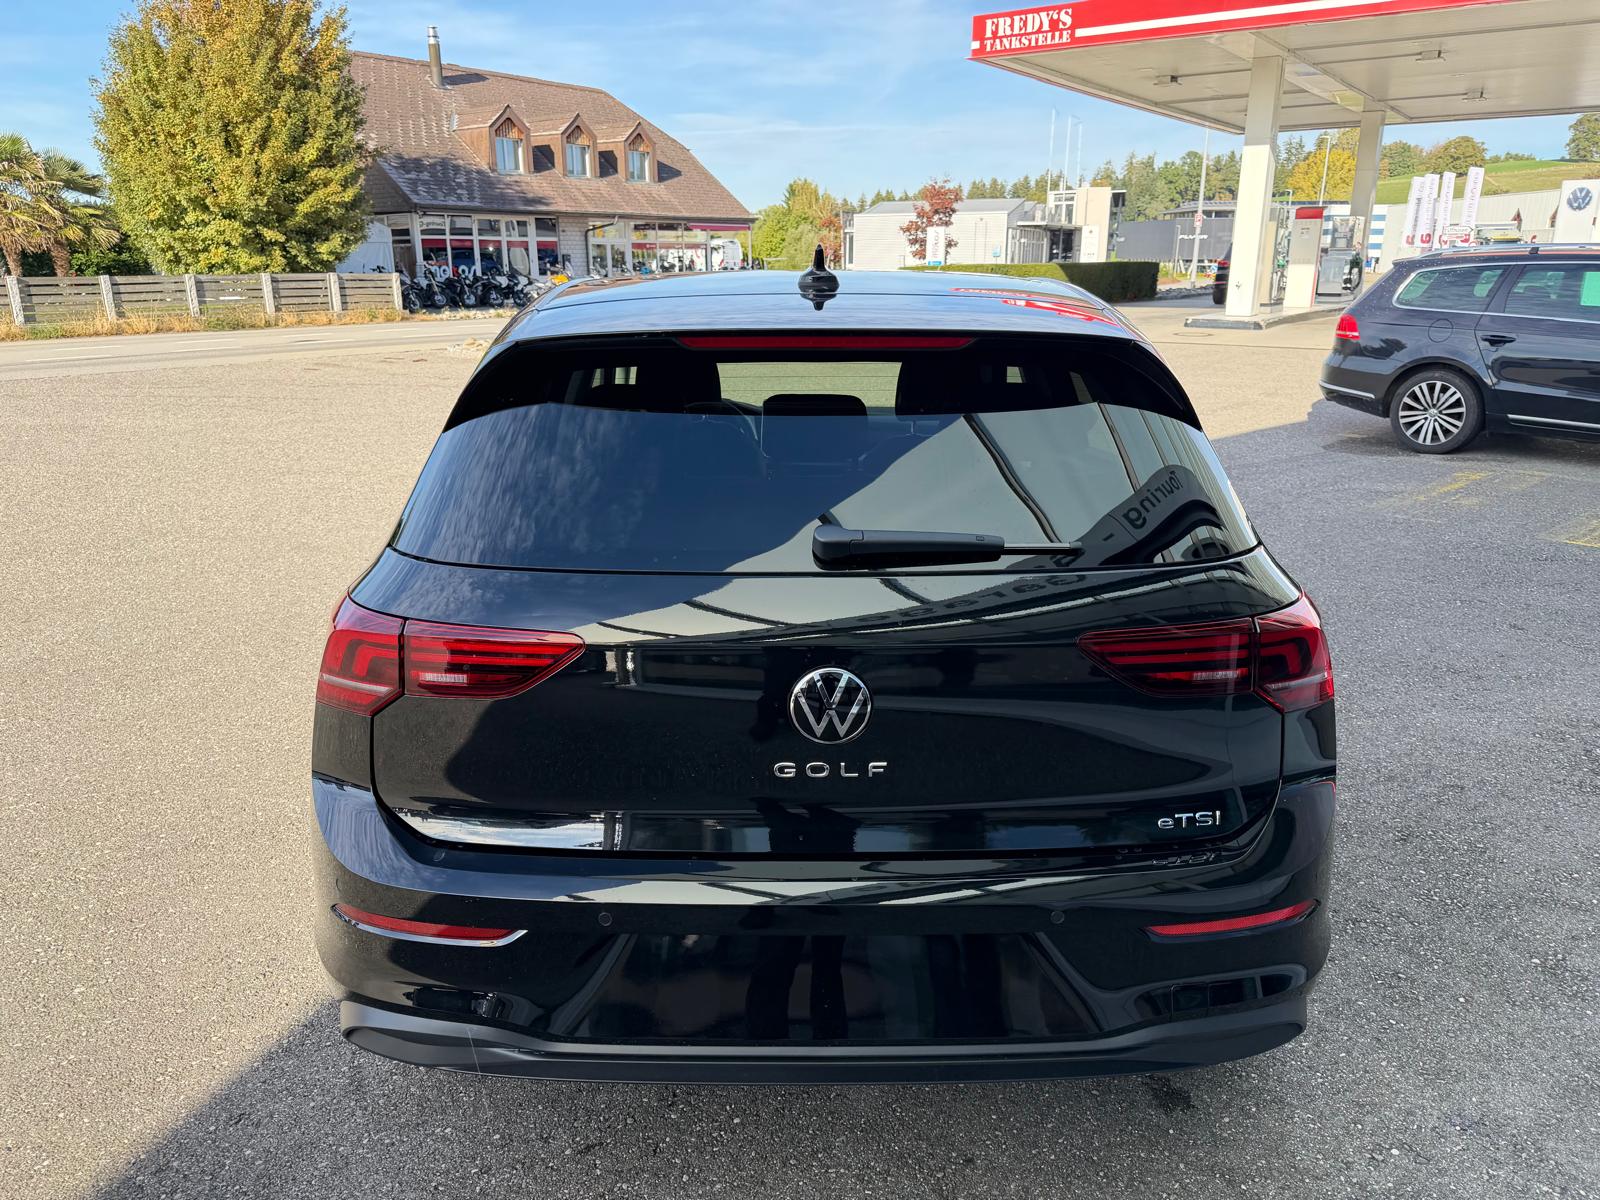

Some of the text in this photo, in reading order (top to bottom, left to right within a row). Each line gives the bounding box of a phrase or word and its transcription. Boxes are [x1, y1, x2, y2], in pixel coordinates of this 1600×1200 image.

[984, 30, 1071, 52] TANKSTELLE
[790, 667, 871, 744] VW
[774, 762, 887, 778] GOLF
[1158, 810, 1221, 829] eTSI
